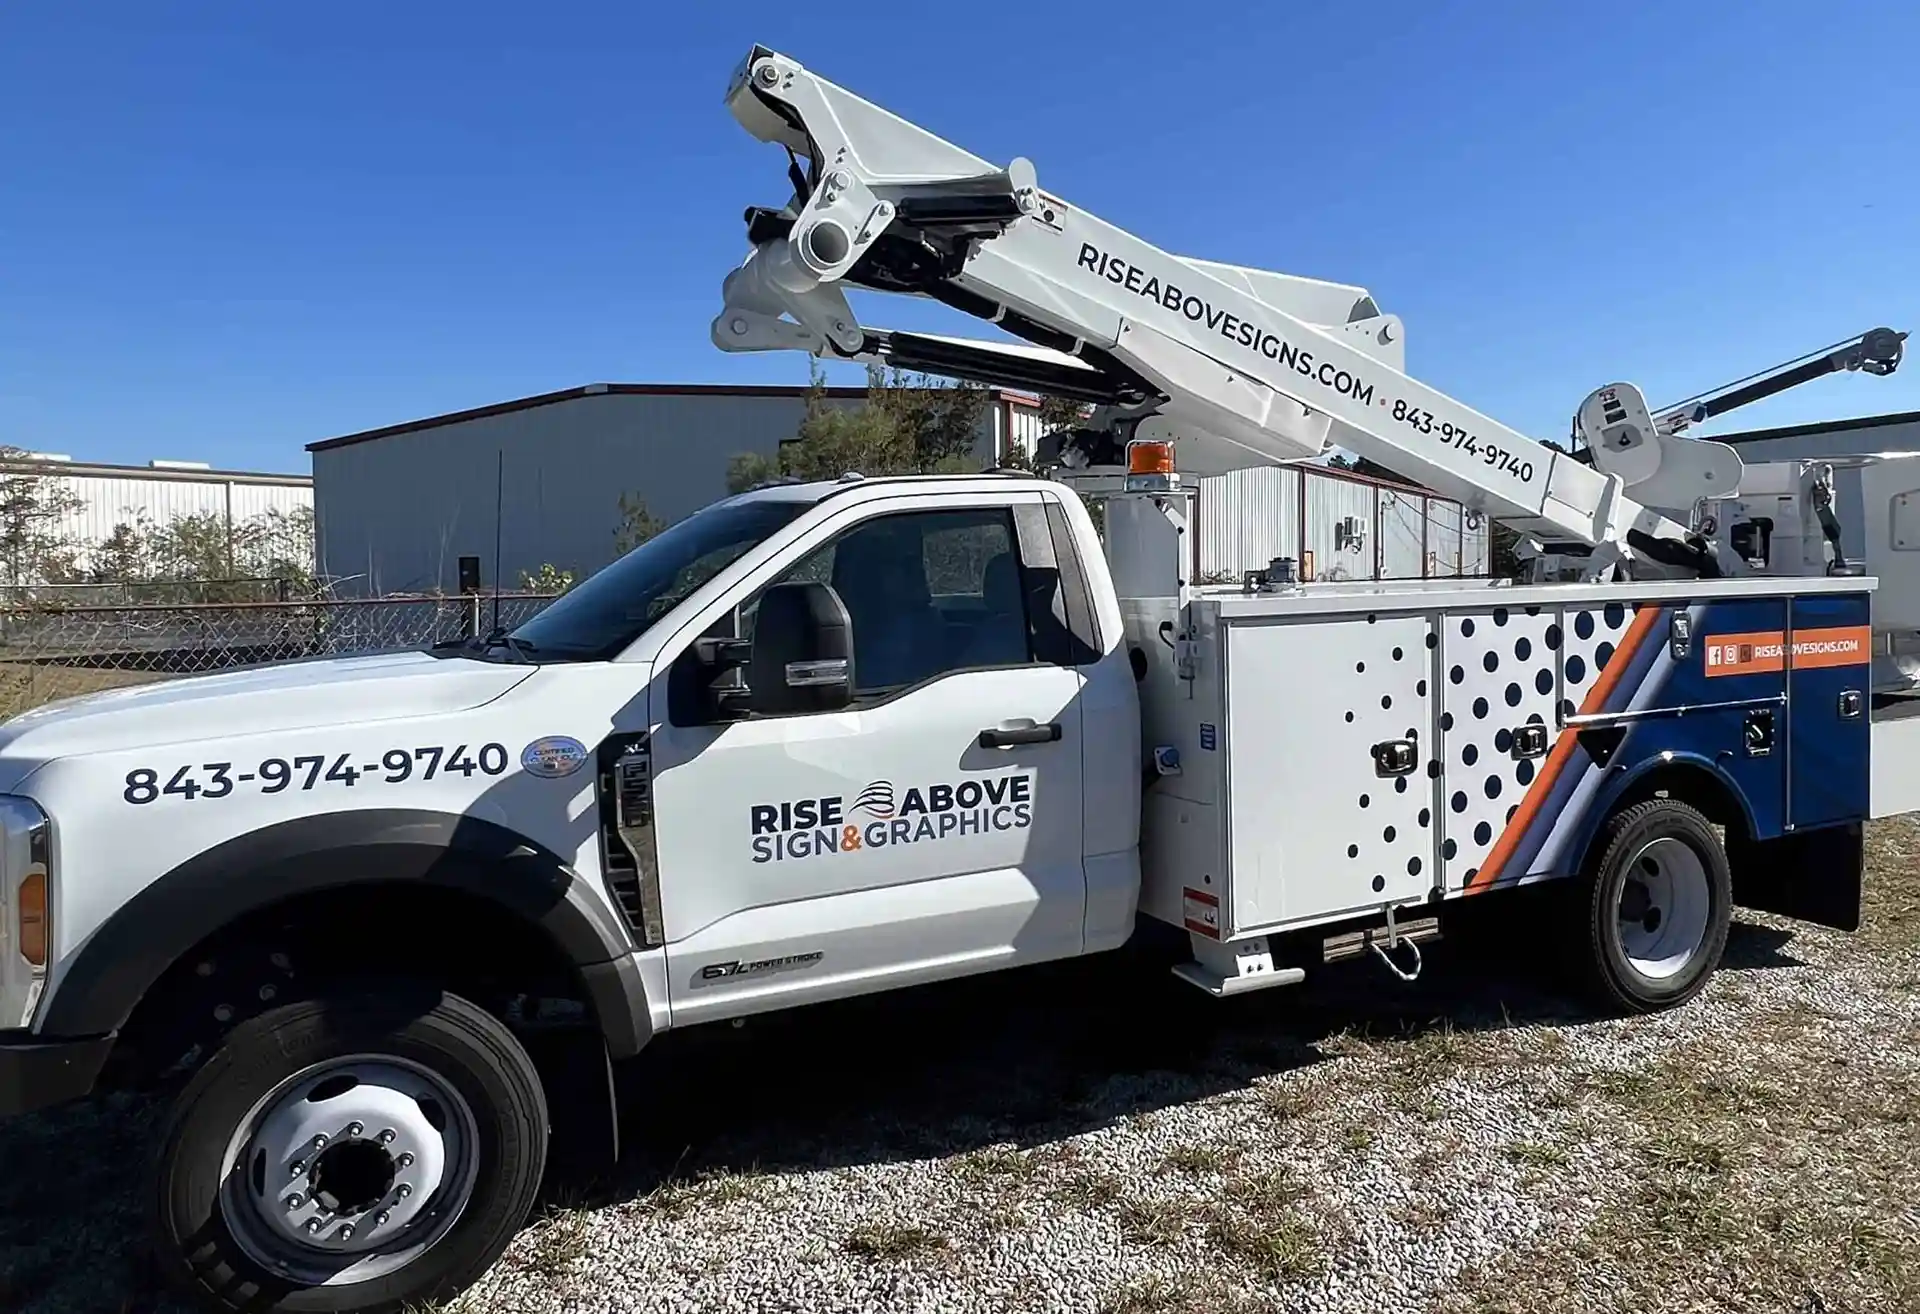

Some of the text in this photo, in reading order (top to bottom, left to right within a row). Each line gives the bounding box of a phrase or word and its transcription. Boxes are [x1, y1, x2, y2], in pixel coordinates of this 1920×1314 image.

[1077, 242, 1533, 484] RISEABOVESIGNS.COM 843-974-9740
[1754, 640, 1858, 658] RISEAOVESIGNS.COM
[123, 742, 509, 805] 843-974-9740
[624, 743, 645, 754] XL
[751, 774, 1030, 836] RISE ABOVE
